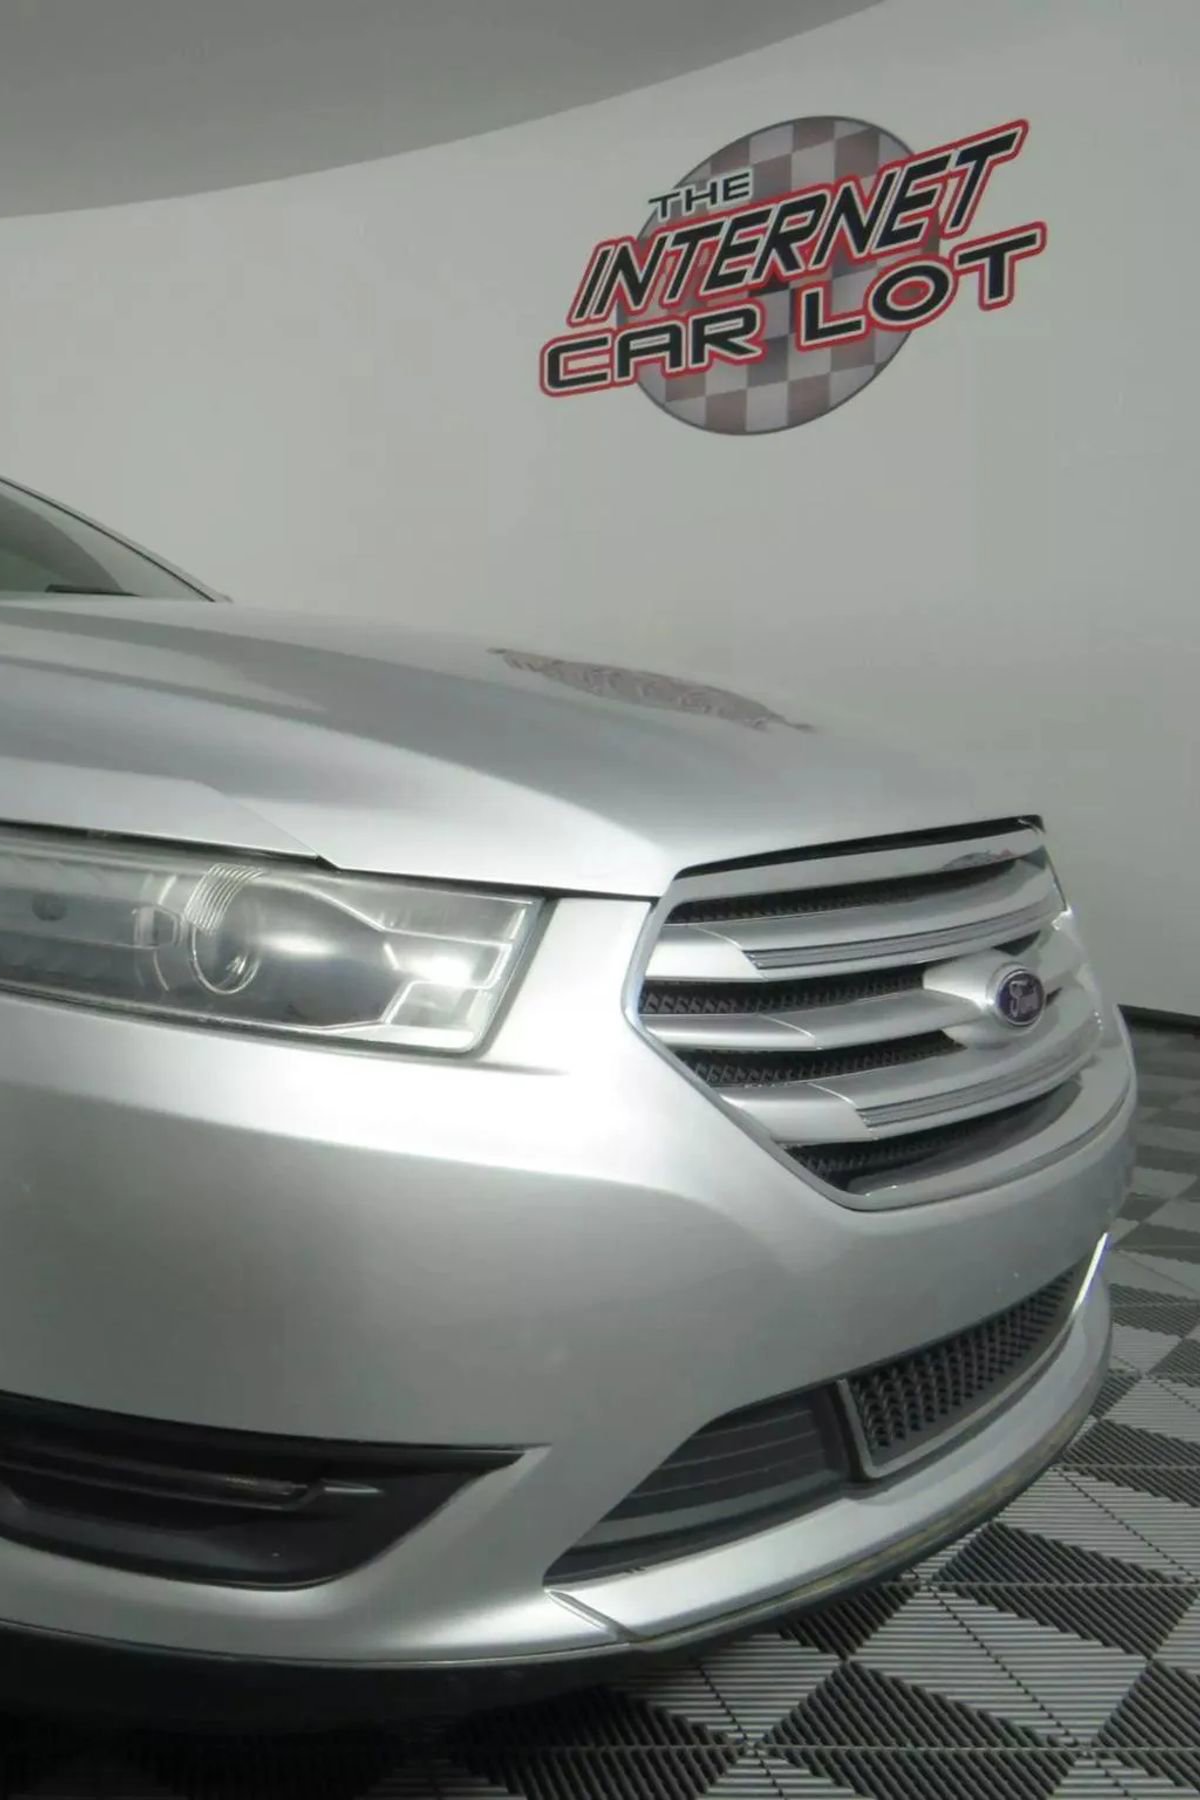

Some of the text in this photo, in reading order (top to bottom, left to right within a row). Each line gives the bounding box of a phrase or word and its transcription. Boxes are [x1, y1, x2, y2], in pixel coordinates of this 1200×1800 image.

[572, 123, 1023, 323] INTERNET
[648, 170, 751, 220] THE
[544, 227, 1043, 394] CAR LOT
